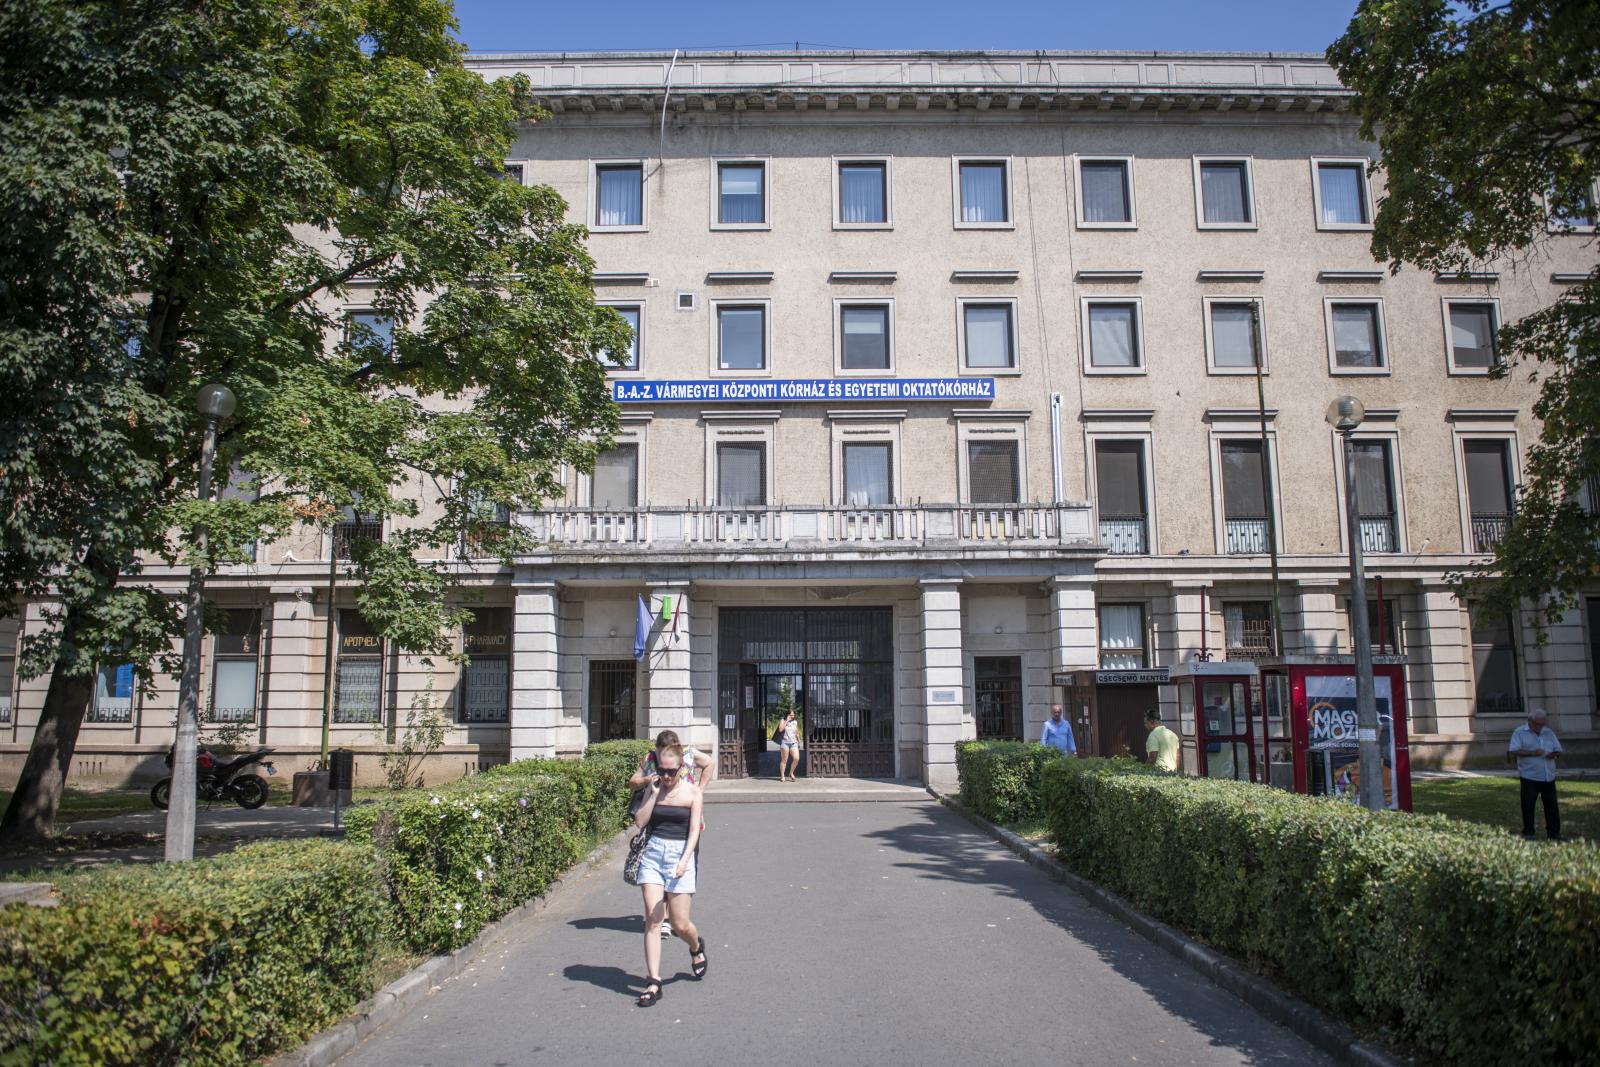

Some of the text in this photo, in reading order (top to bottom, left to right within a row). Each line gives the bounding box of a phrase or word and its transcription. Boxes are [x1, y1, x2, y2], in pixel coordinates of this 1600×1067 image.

[617, 380, 991, 399] B.-A.-Z. VÁRMEGYEI KÖZPONTI KÓRHÁZ ÉS EGYETEMI OKTATÓKÓRHÁZ
